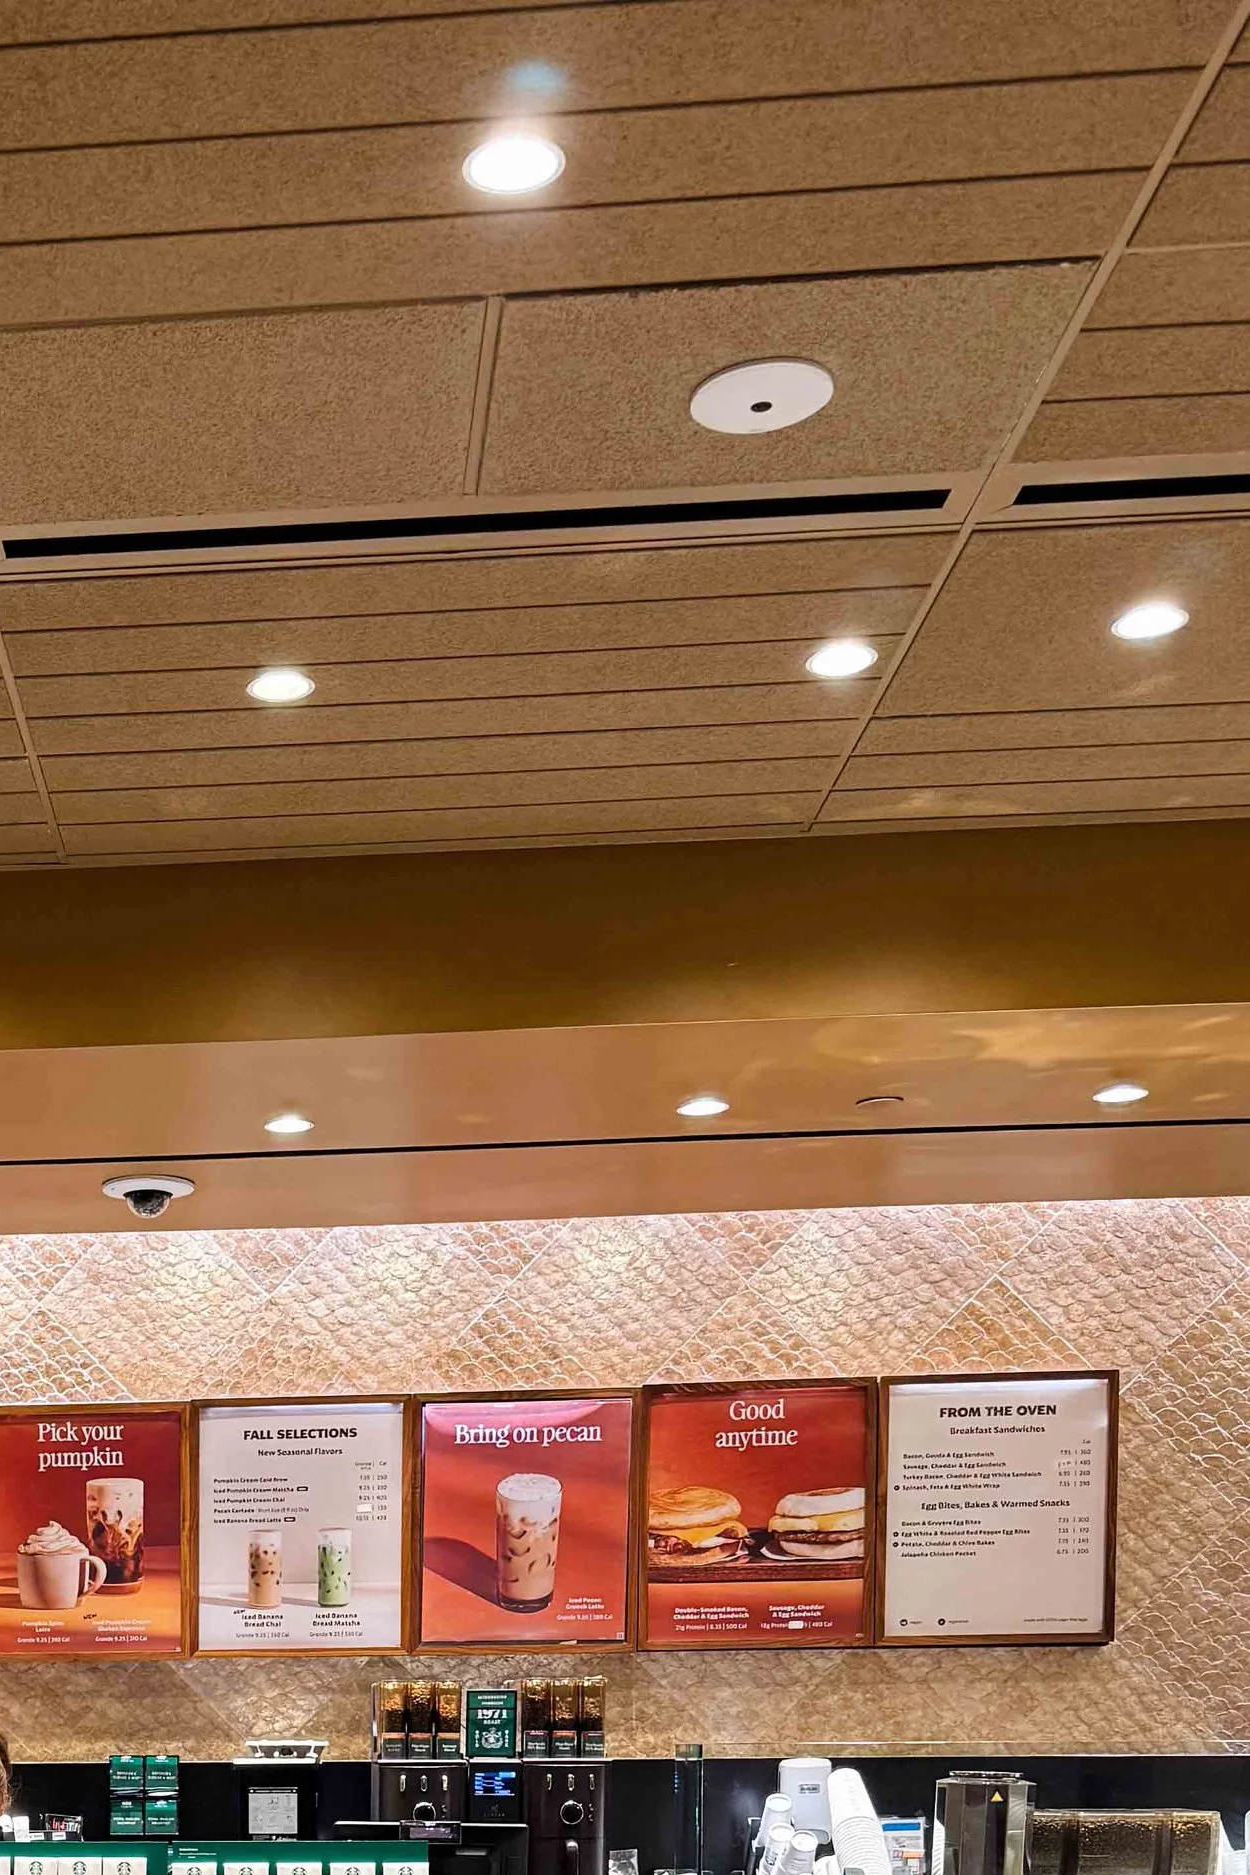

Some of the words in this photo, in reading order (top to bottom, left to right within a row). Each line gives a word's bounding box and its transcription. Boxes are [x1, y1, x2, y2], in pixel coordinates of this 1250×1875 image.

[729, 1398, 785, 1421] Good
[940, 1406, 981, 1418] FROM
[985, 1406, 1012, 1417] THE
[1016, 1405, 1057, 1416] OVEN
[37, 1422, 78, 1443] Pick
[80, 1425, 124, 1443] your
[244, 1430, 274, 1440] FALL
[277, 1428, 358, 1439] SELECTIONS
[454, 1424, 510, 1448] Bring
[513, 1427, 539, 1443] on
[542, 1425, 602, 1446] pecan
[950, 1427, 992, 1435] Breakfast
[993, 1425, 1045, 1434] Sandwiches
[715, 1427, 799, 1450] anytime
[277, 1448, 313, 1456] Seasonal
[37, 1446, 124, 1472] pumpkin
[921, 1503, 937, 1511] Egg
[938, 1502, 962, 1510] Bites,
[1040, 1499, 1070, 1507] Snacks
[477, 1709, 507, 1719] 1971
